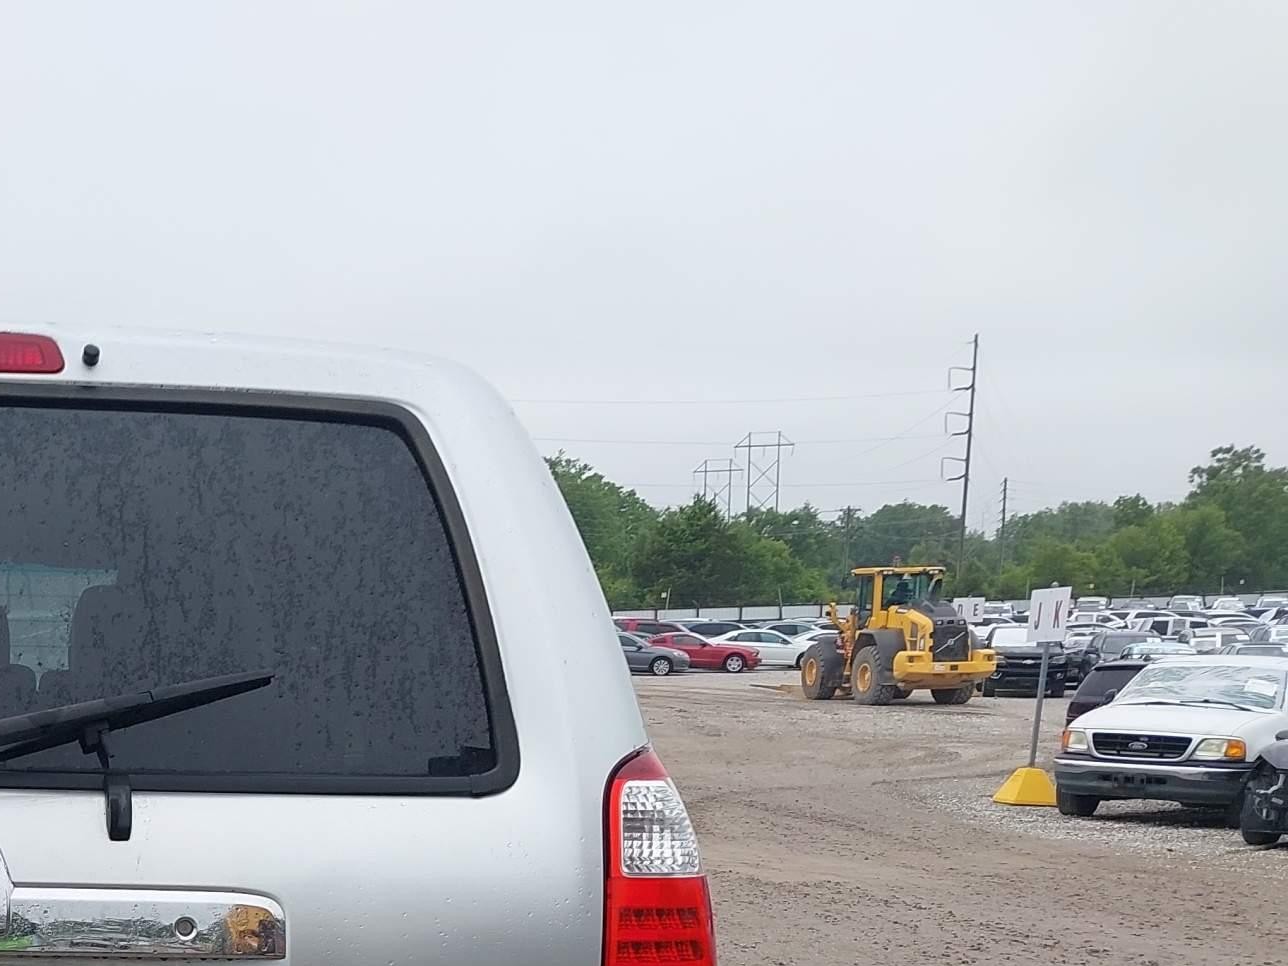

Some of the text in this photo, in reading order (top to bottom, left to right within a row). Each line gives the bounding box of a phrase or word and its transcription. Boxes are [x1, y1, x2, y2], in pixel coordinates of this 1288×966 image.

[973, 603, 979, 617] E
[1034, 600, 1063, 630] J K
